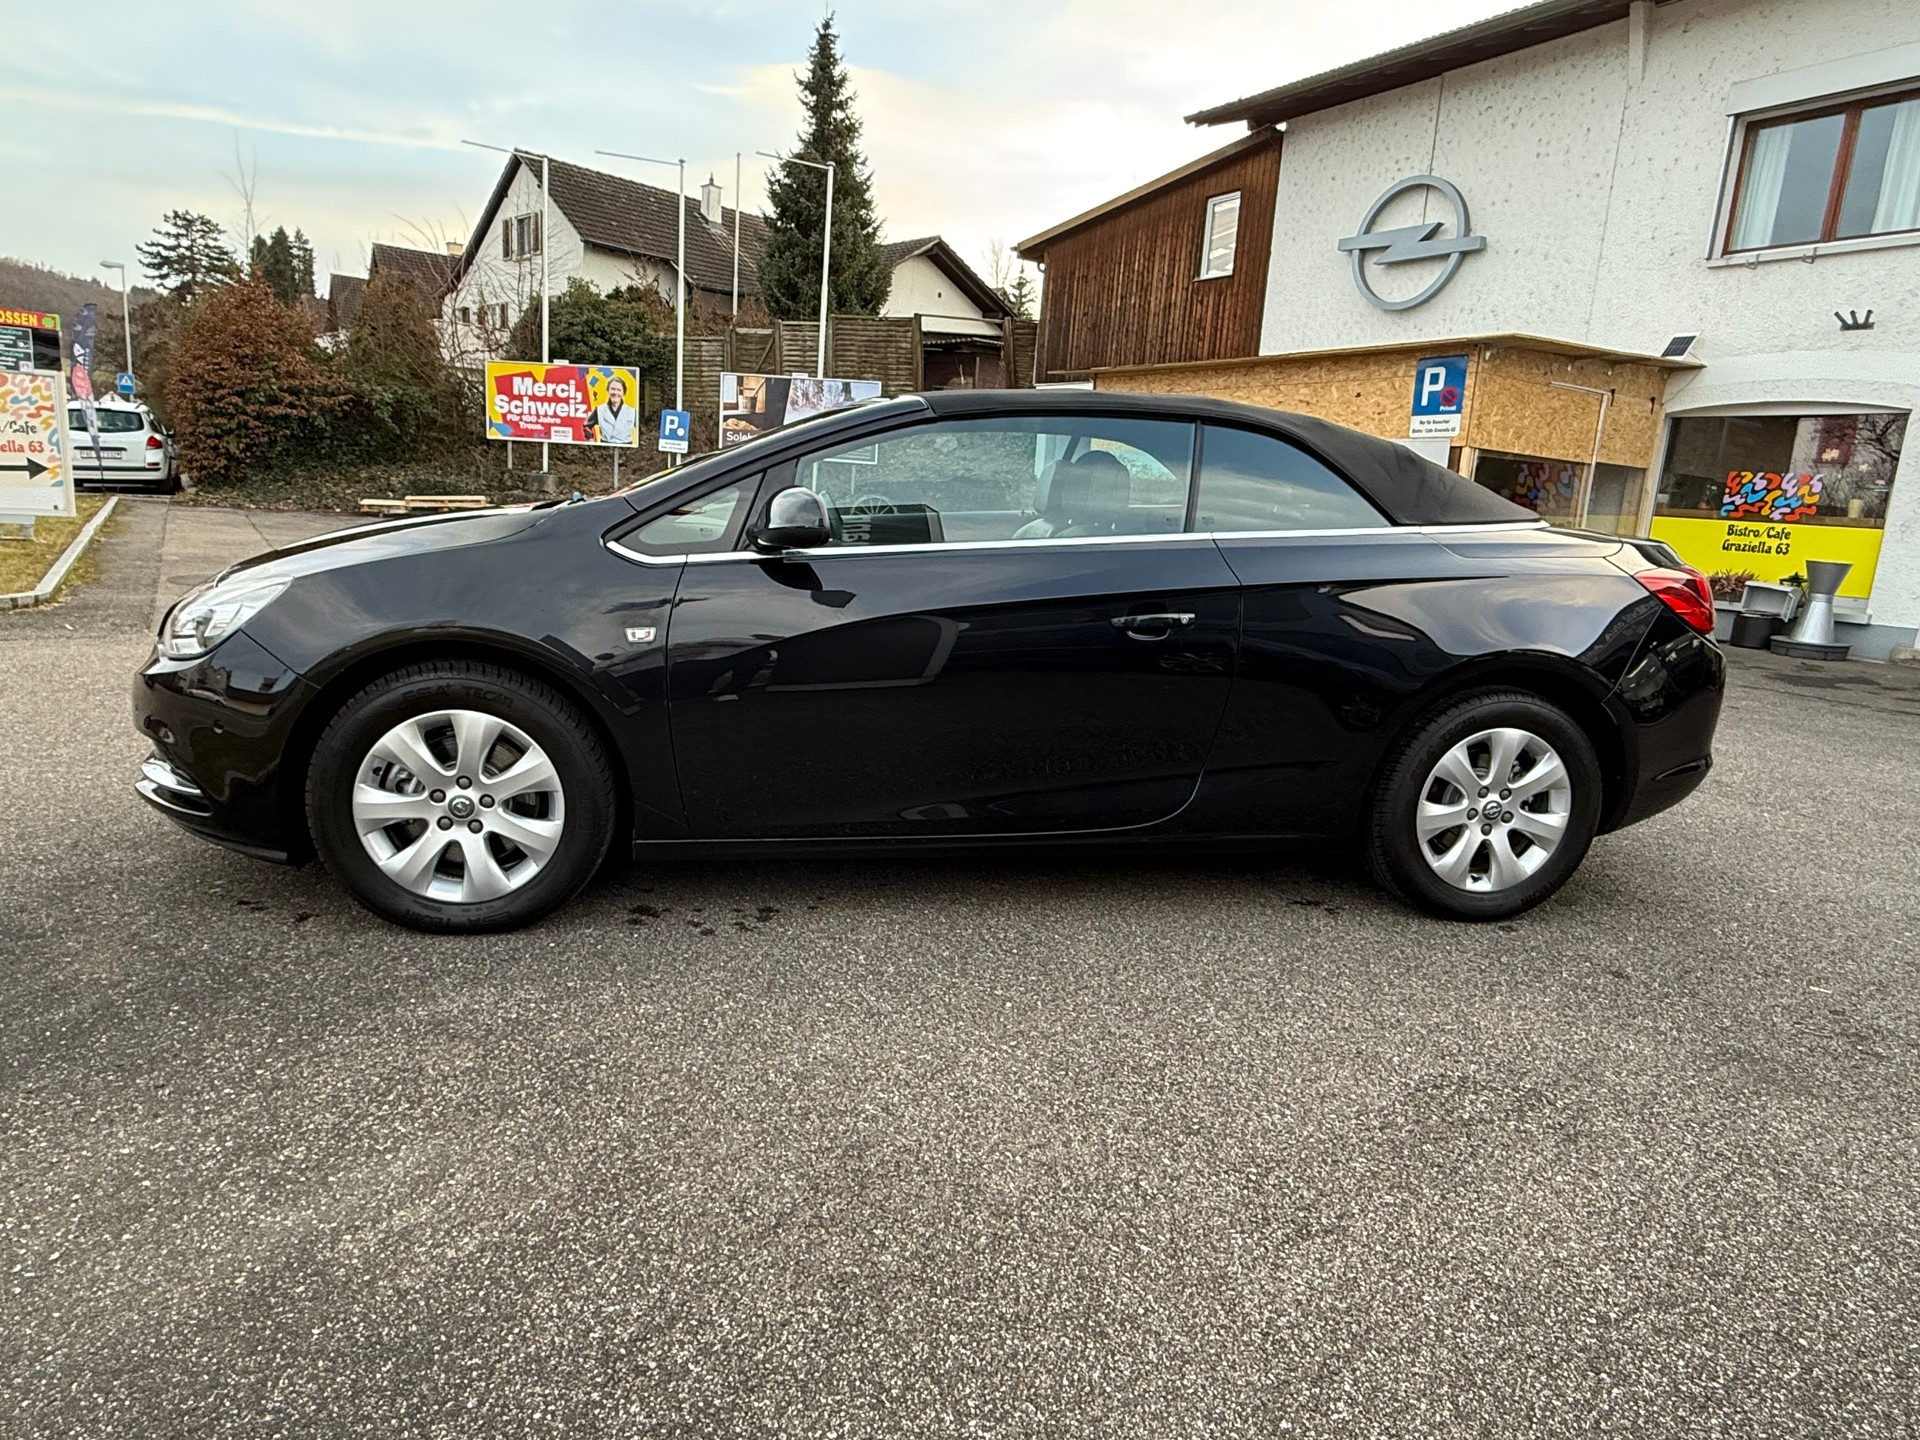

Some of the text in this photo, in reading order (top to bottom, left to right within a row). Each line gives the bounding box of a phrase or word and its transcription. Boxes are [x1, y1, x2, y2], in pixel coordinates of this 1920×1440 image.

[512, 376, 583, 402] Merci,
[1421, 366, 1446, 406] P
[506, 413, 561, 425] Für 100 Jahre
[665, 415, 679, 436] P
[28, 440, 45, 453] 63
[1727, 524, 1791, 541] Bistro/Cafe
[1722, 538, 1791, 556] Graziella 63
